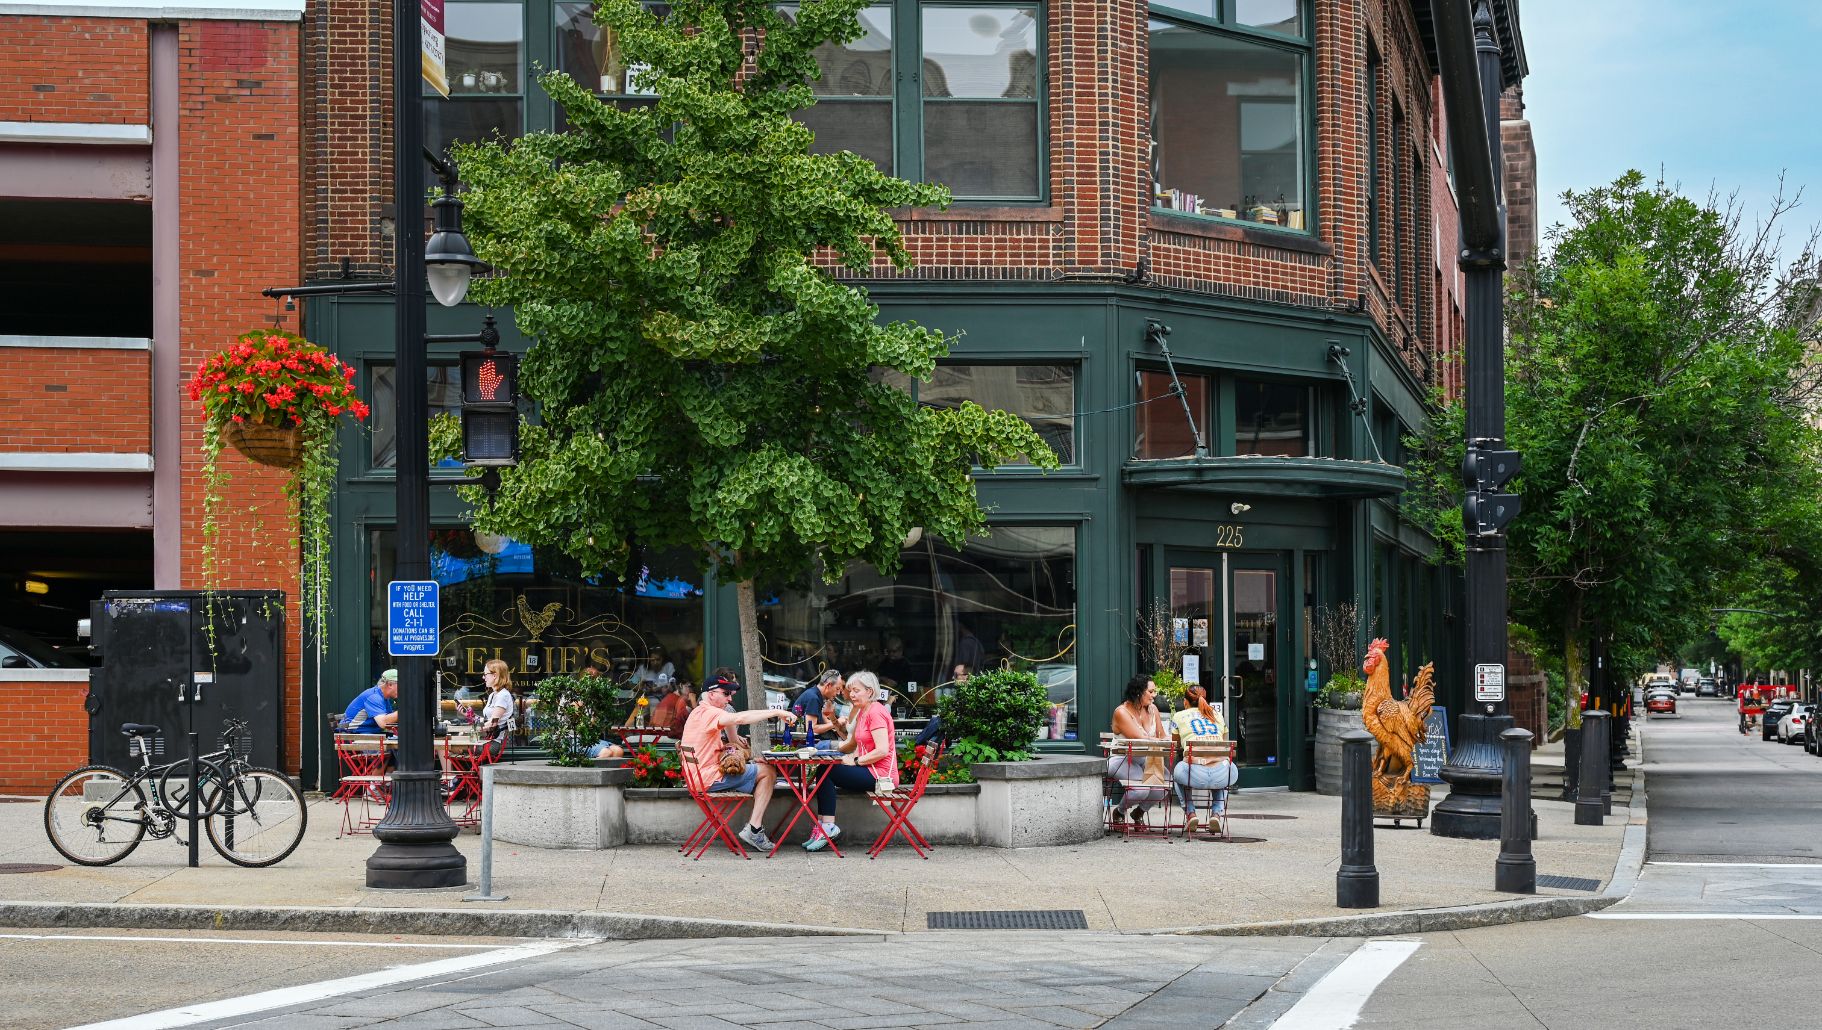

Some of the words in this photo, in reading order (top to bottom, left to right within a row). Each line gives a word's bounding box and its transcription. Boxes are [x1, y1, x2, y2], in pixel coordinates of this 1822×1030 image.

[1217, 526, 1243, 547] 225
[404, 592, 424, 600] HELP
[404, 609, 424, 617] CALL
[1190, 719, 1218, 736] 05
